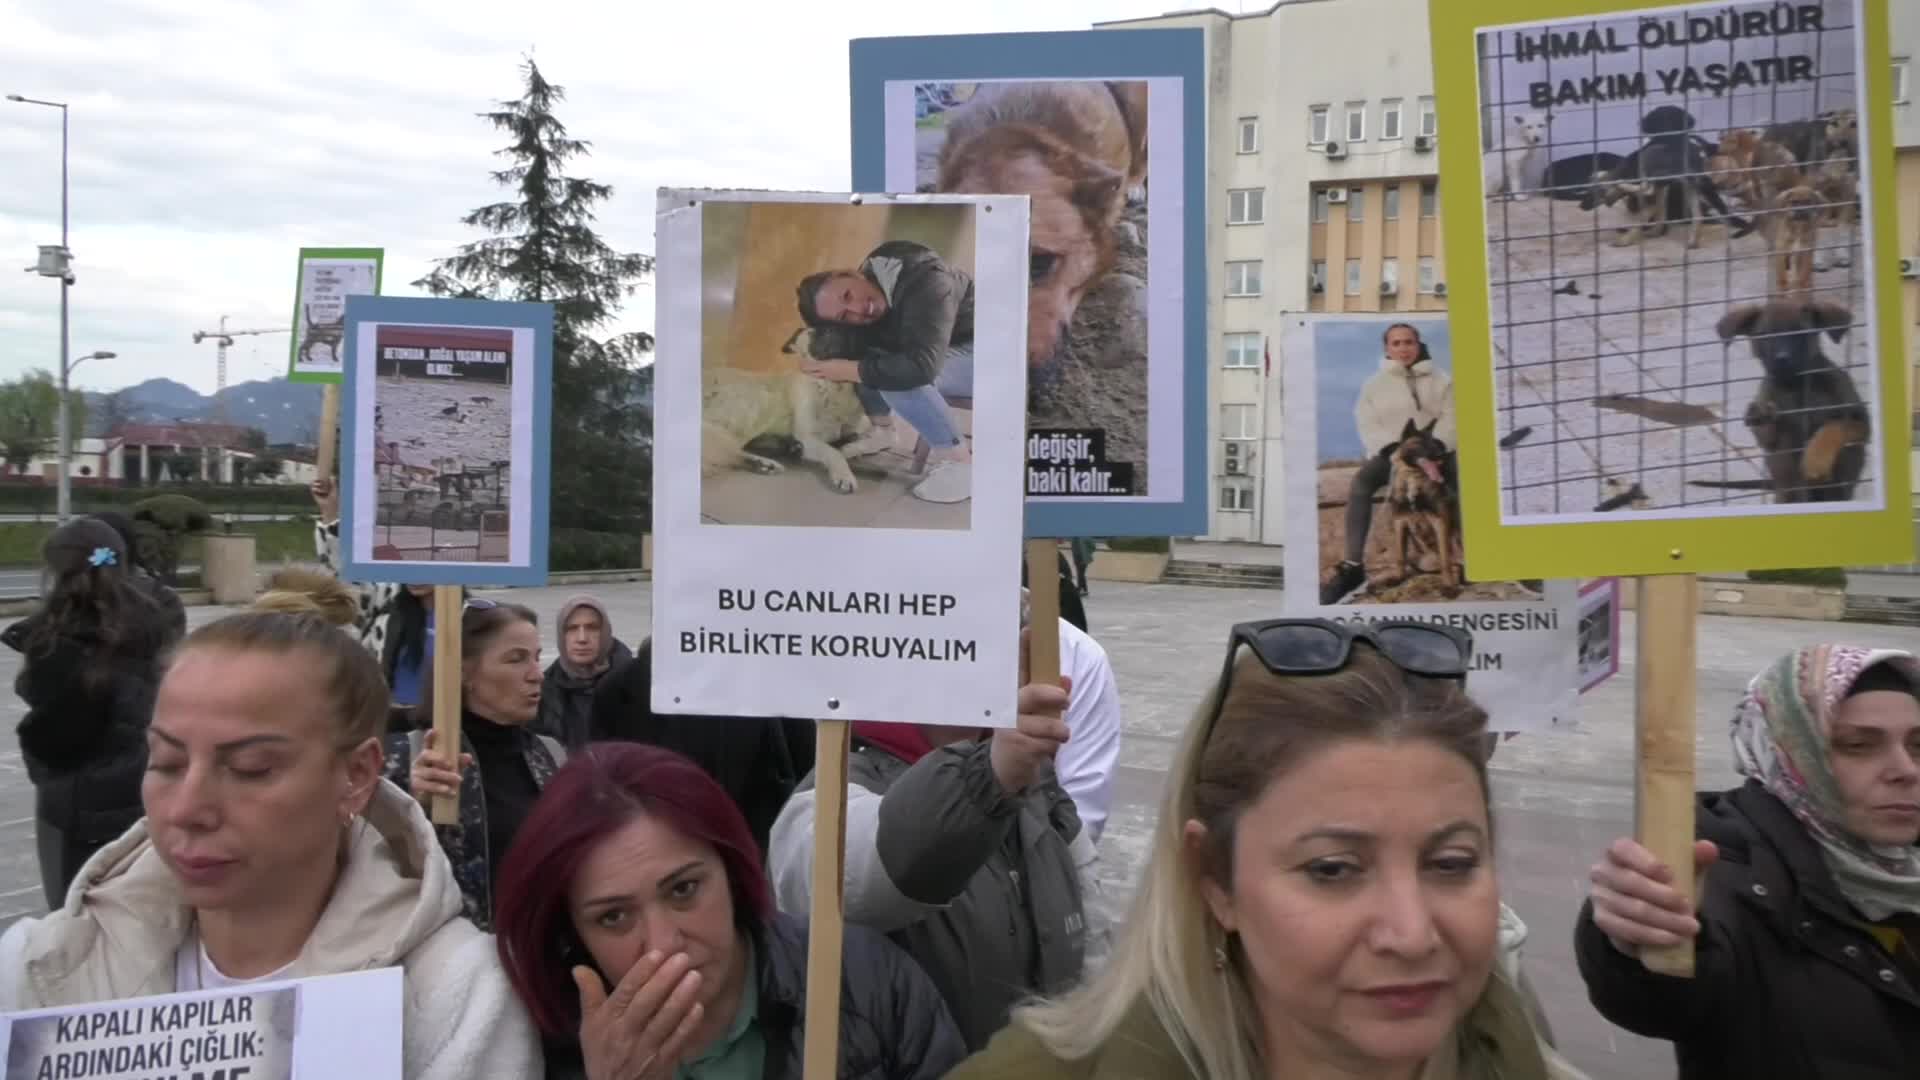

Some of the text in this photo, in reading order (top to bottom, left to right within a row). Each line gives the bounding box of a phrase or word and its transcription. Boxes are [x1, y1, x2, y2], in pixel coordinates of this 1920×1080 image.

[1514, 2, 1825, 63] İHMAL ÖLDÜRÜR
[1529, 55, 1814, 109] BAKIM YAŞATIR
[1028, 433, 1095, 465] değişir,
[1028, 467, 1127, 493] baki kalır...
[718, 589, 957, 616] BU CANLARI HEP
[680, 626, 977, 662] BİRLİKTE KORUYALIM
[55, 996, 254, 1044] KAPALI KAPILAR
[37, 1029, 265, 1080] ARDINDAKİ ÇIĞLIK:
